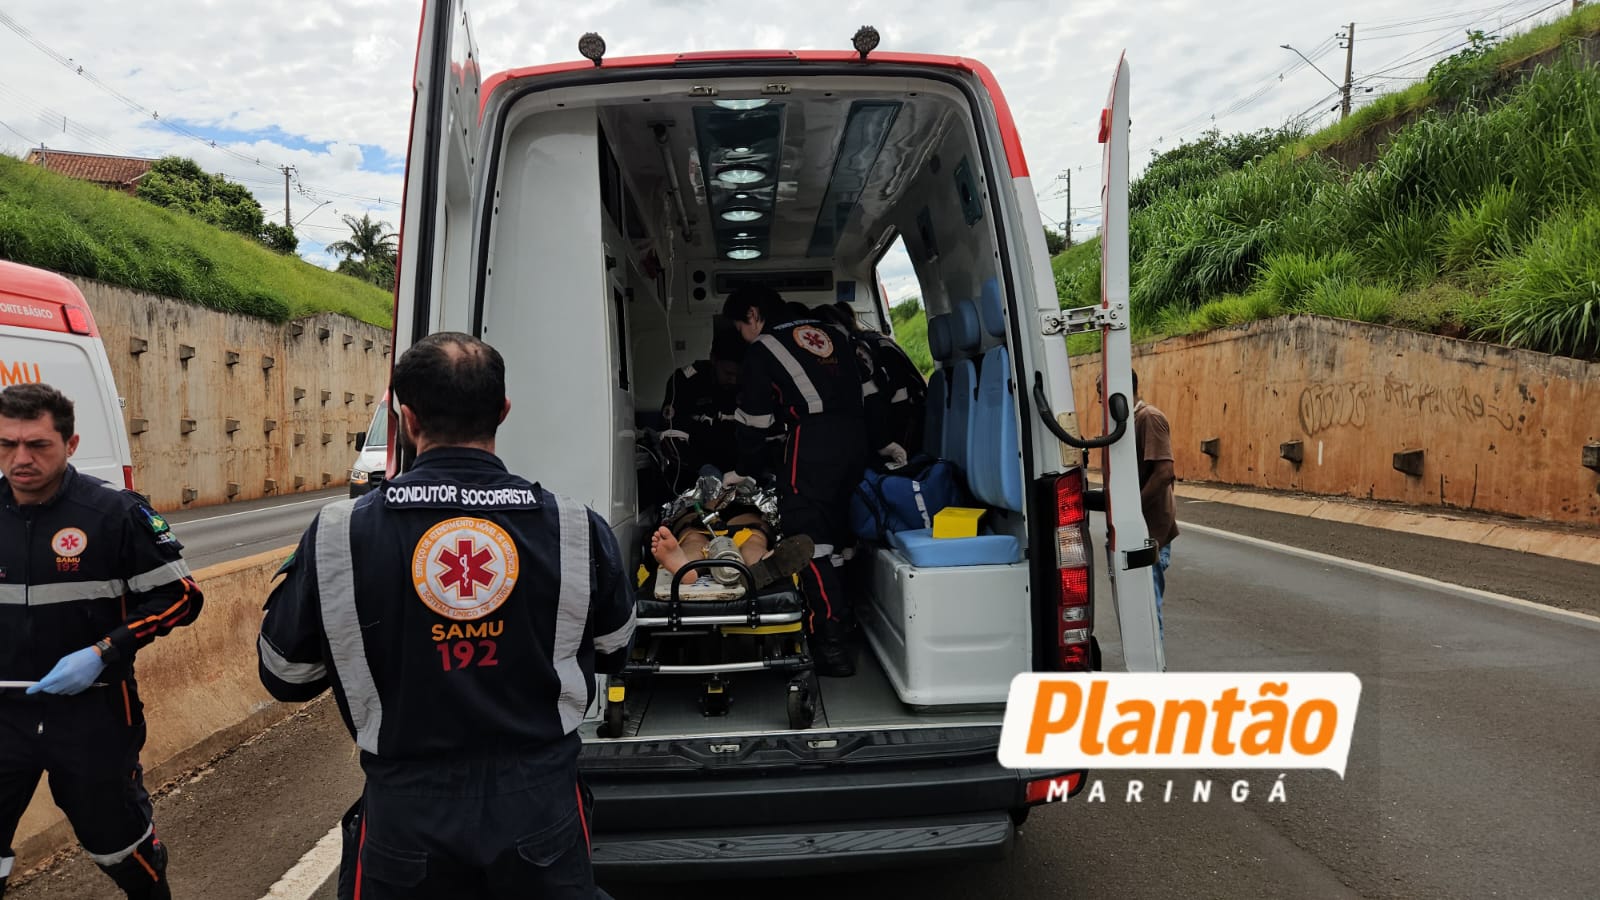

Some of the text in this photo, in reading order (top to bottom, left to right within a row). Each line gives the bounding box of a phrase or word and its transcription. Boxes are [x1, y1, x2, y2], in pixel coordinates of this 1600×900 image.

[23, 304, 53, 319] BÁSICO
[386, 485, 536, 505] CONDUTOR SOCORRISTA
[57, 563, 80, 572] 192
[431, 620, 504, 641] SAMU
[437, 640, 498, 671] 192
